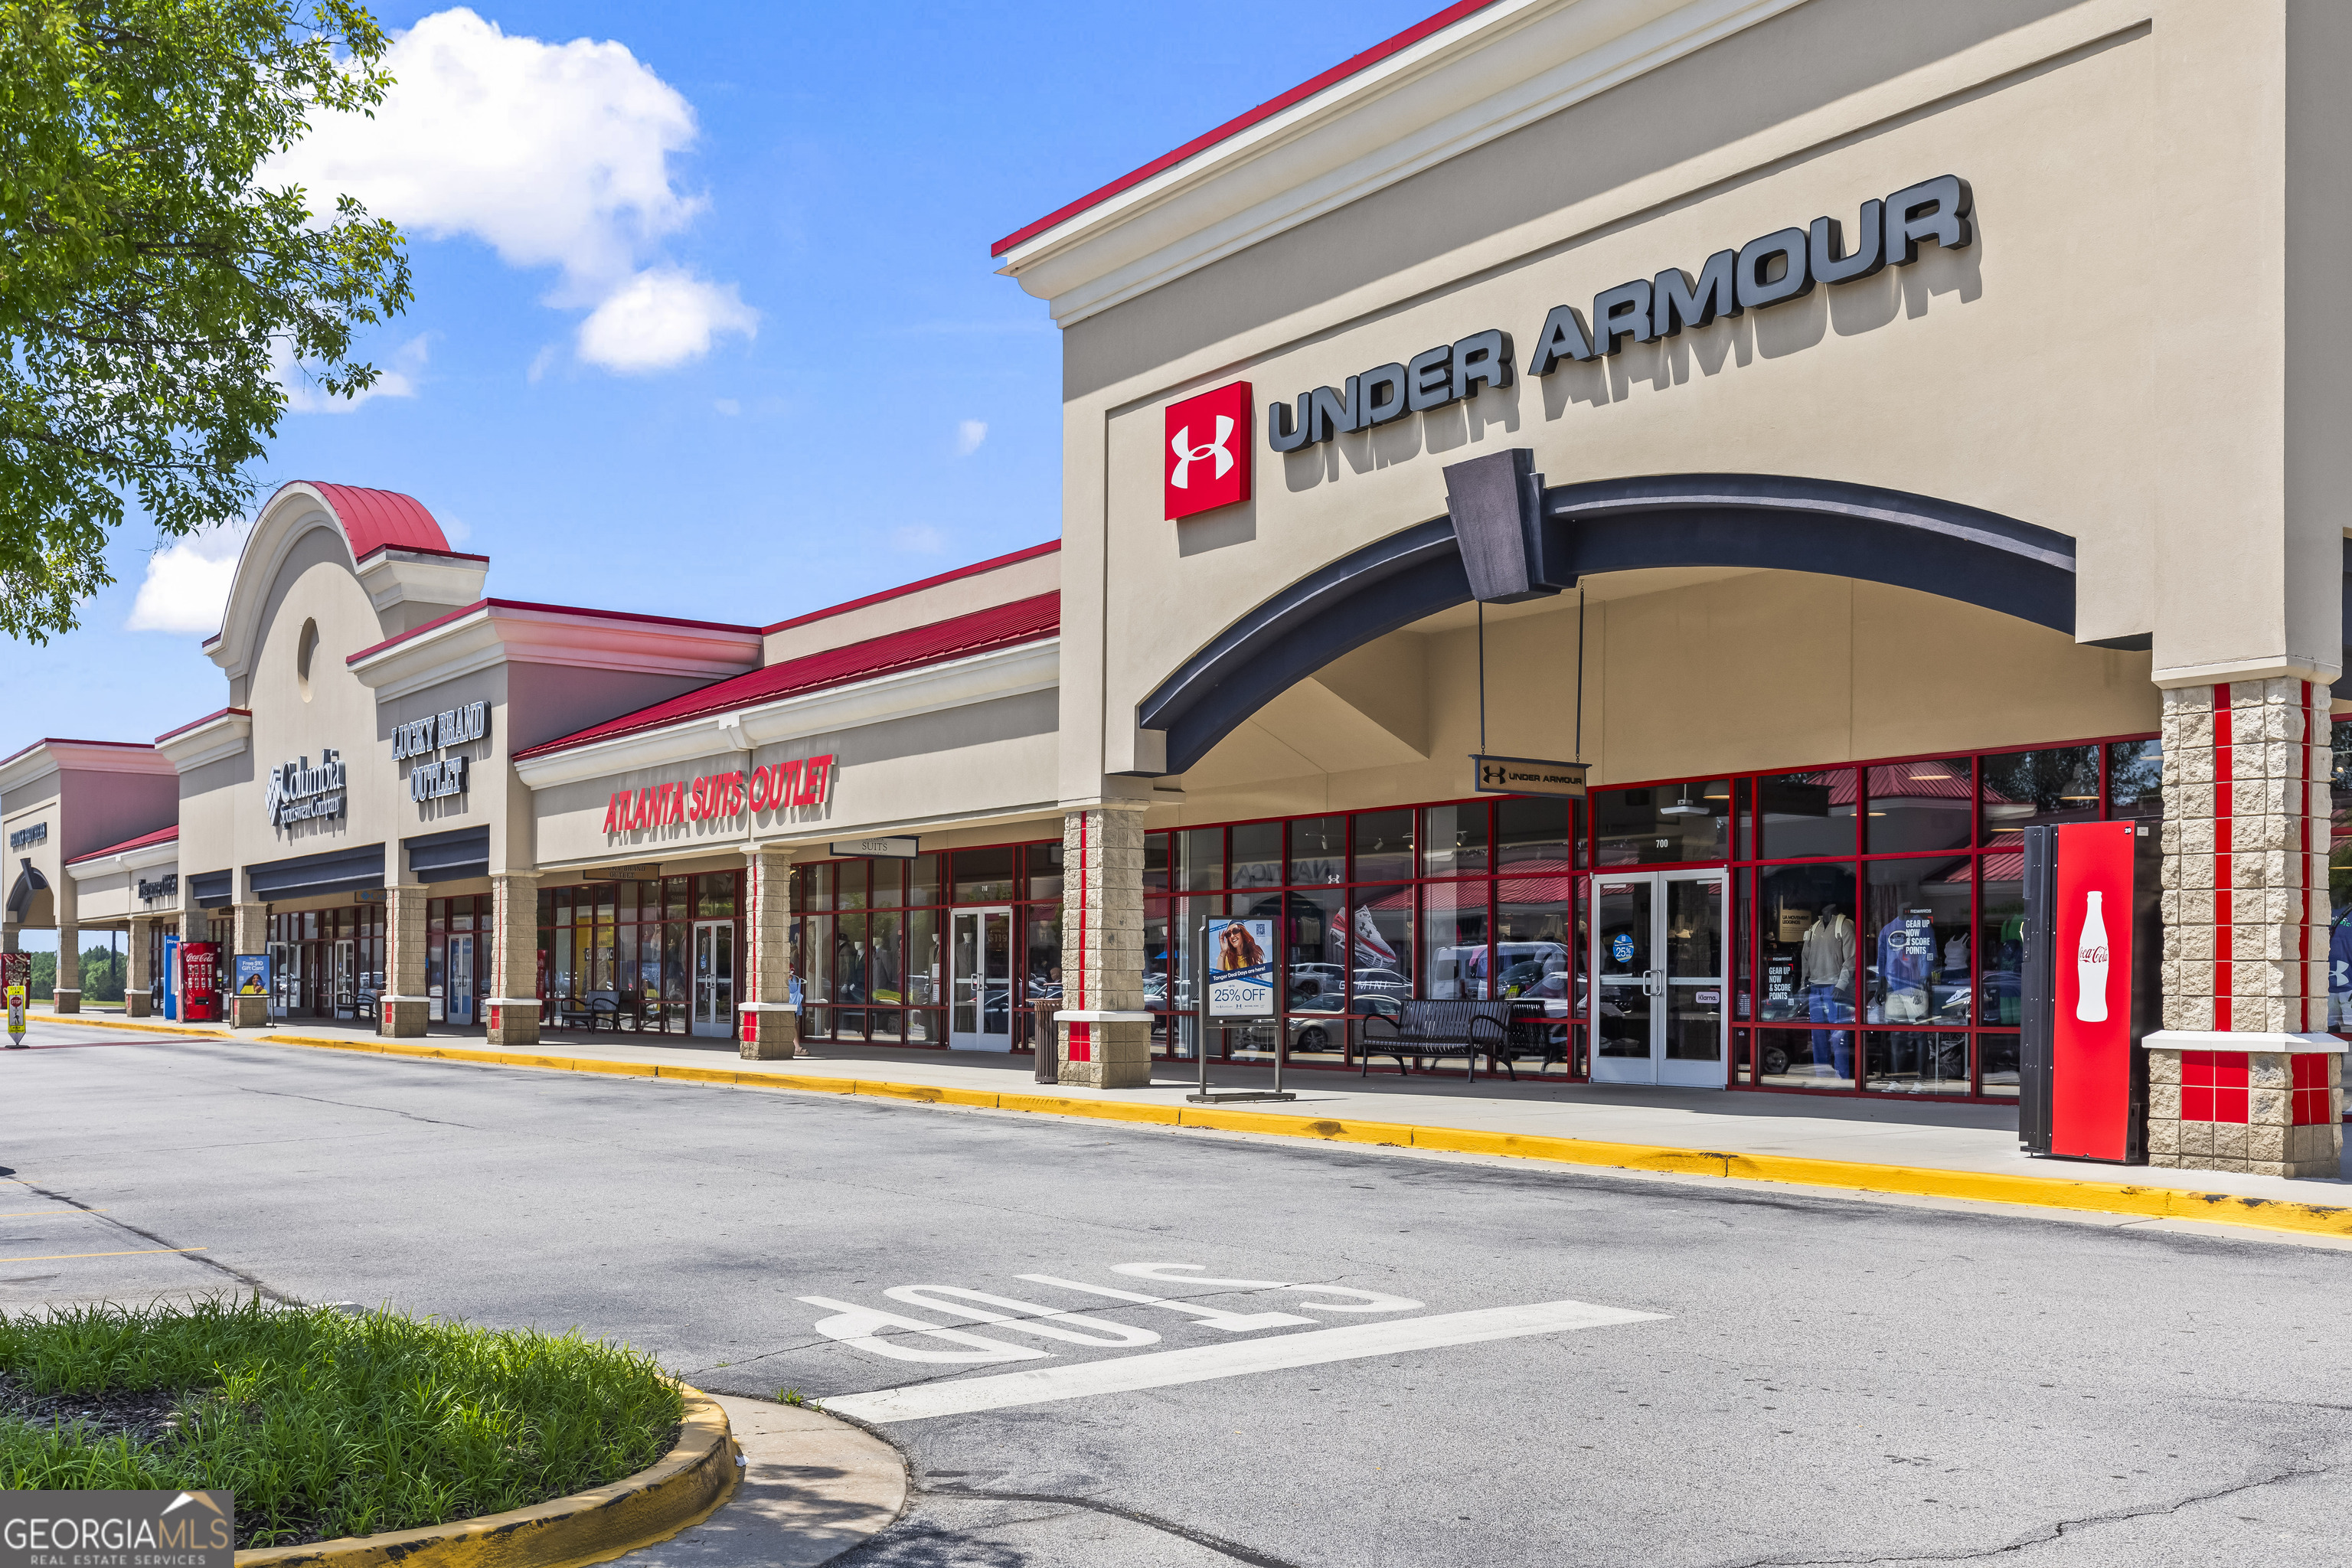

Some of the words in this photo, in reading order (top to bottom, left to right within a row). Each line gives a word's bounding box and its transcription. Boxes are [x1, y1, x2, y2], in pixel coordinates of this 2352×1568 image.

[1269, 328, 1514, 452] UNDER
[1528, 174, 1971, 376] ARMOUR
[391, 715, 436, 761] LUCKY
[438, 701, 488, 750] BRAND
[281, 749, 342, 802] Columbia
[410, 756, 463, 803] OUTLET
[1508, 773, 1540, 782] UNDER
[1542, 775, 1583, 785] ARMOUR
[603, 781, 685, 834] ATLANTA
[690, 770, 744, 822] SUITS
[749, 753, 833, 812] OUTLET
[311, 796, 341, 821] Company
[862, 841, 888, 851] SUITS
[1656, 839, 1668, 848] 700
[1906, 920, 1921, 928] GEAR
[1922, 920, 1930, 928] UP
[1906, 929, 1920, 937] NOW
[1906, 937, 1911, 946] &
[1911, 937, 1930, 946] SCORE
[1615, 947, 1631, 957] 25%
[1906, 946, 1926, 955] POINTS
[185, 952, 214, 962] Coca-Cola
[1774, 983, 1791, 991] SCORE
[1214, 988, 1240, 1001] 25%
[1242, 988, 1266, 1001] OFF
[1769, 991, 1788, 1000] POINTS
[793, 1262, 1425, 1364] STOP
